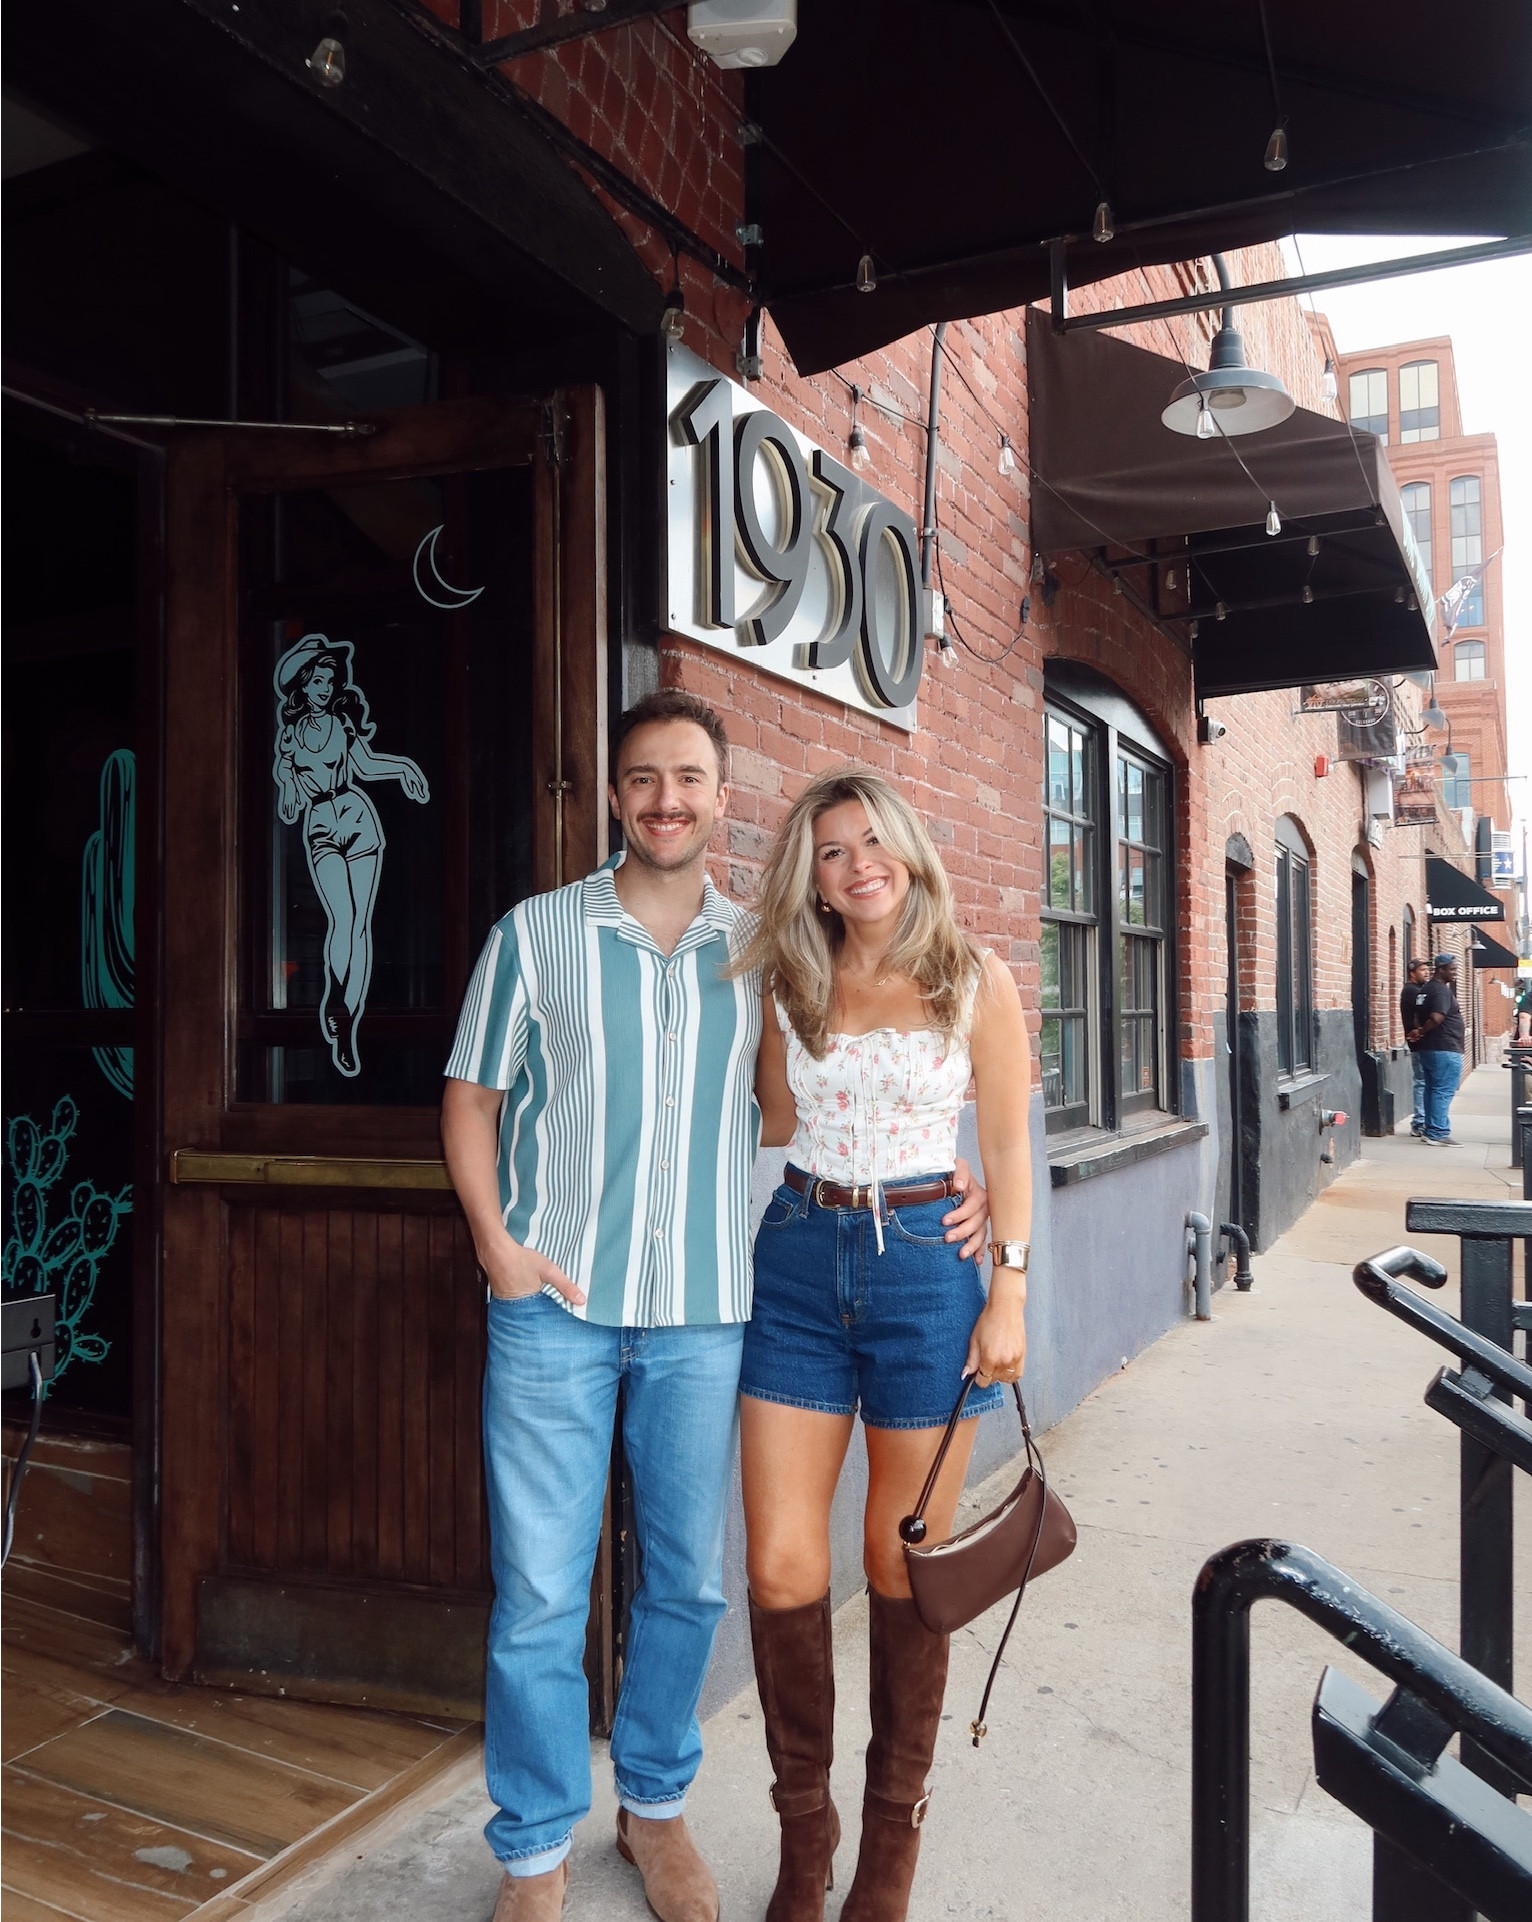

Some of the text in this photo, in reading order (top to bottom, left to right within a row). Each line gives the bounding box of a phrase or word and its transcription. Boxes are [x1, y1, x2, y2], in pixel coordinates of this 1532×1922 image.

[680, 377, 924, 707] 1930
[1433, 906, 1498, 916] BOX OFFICE
